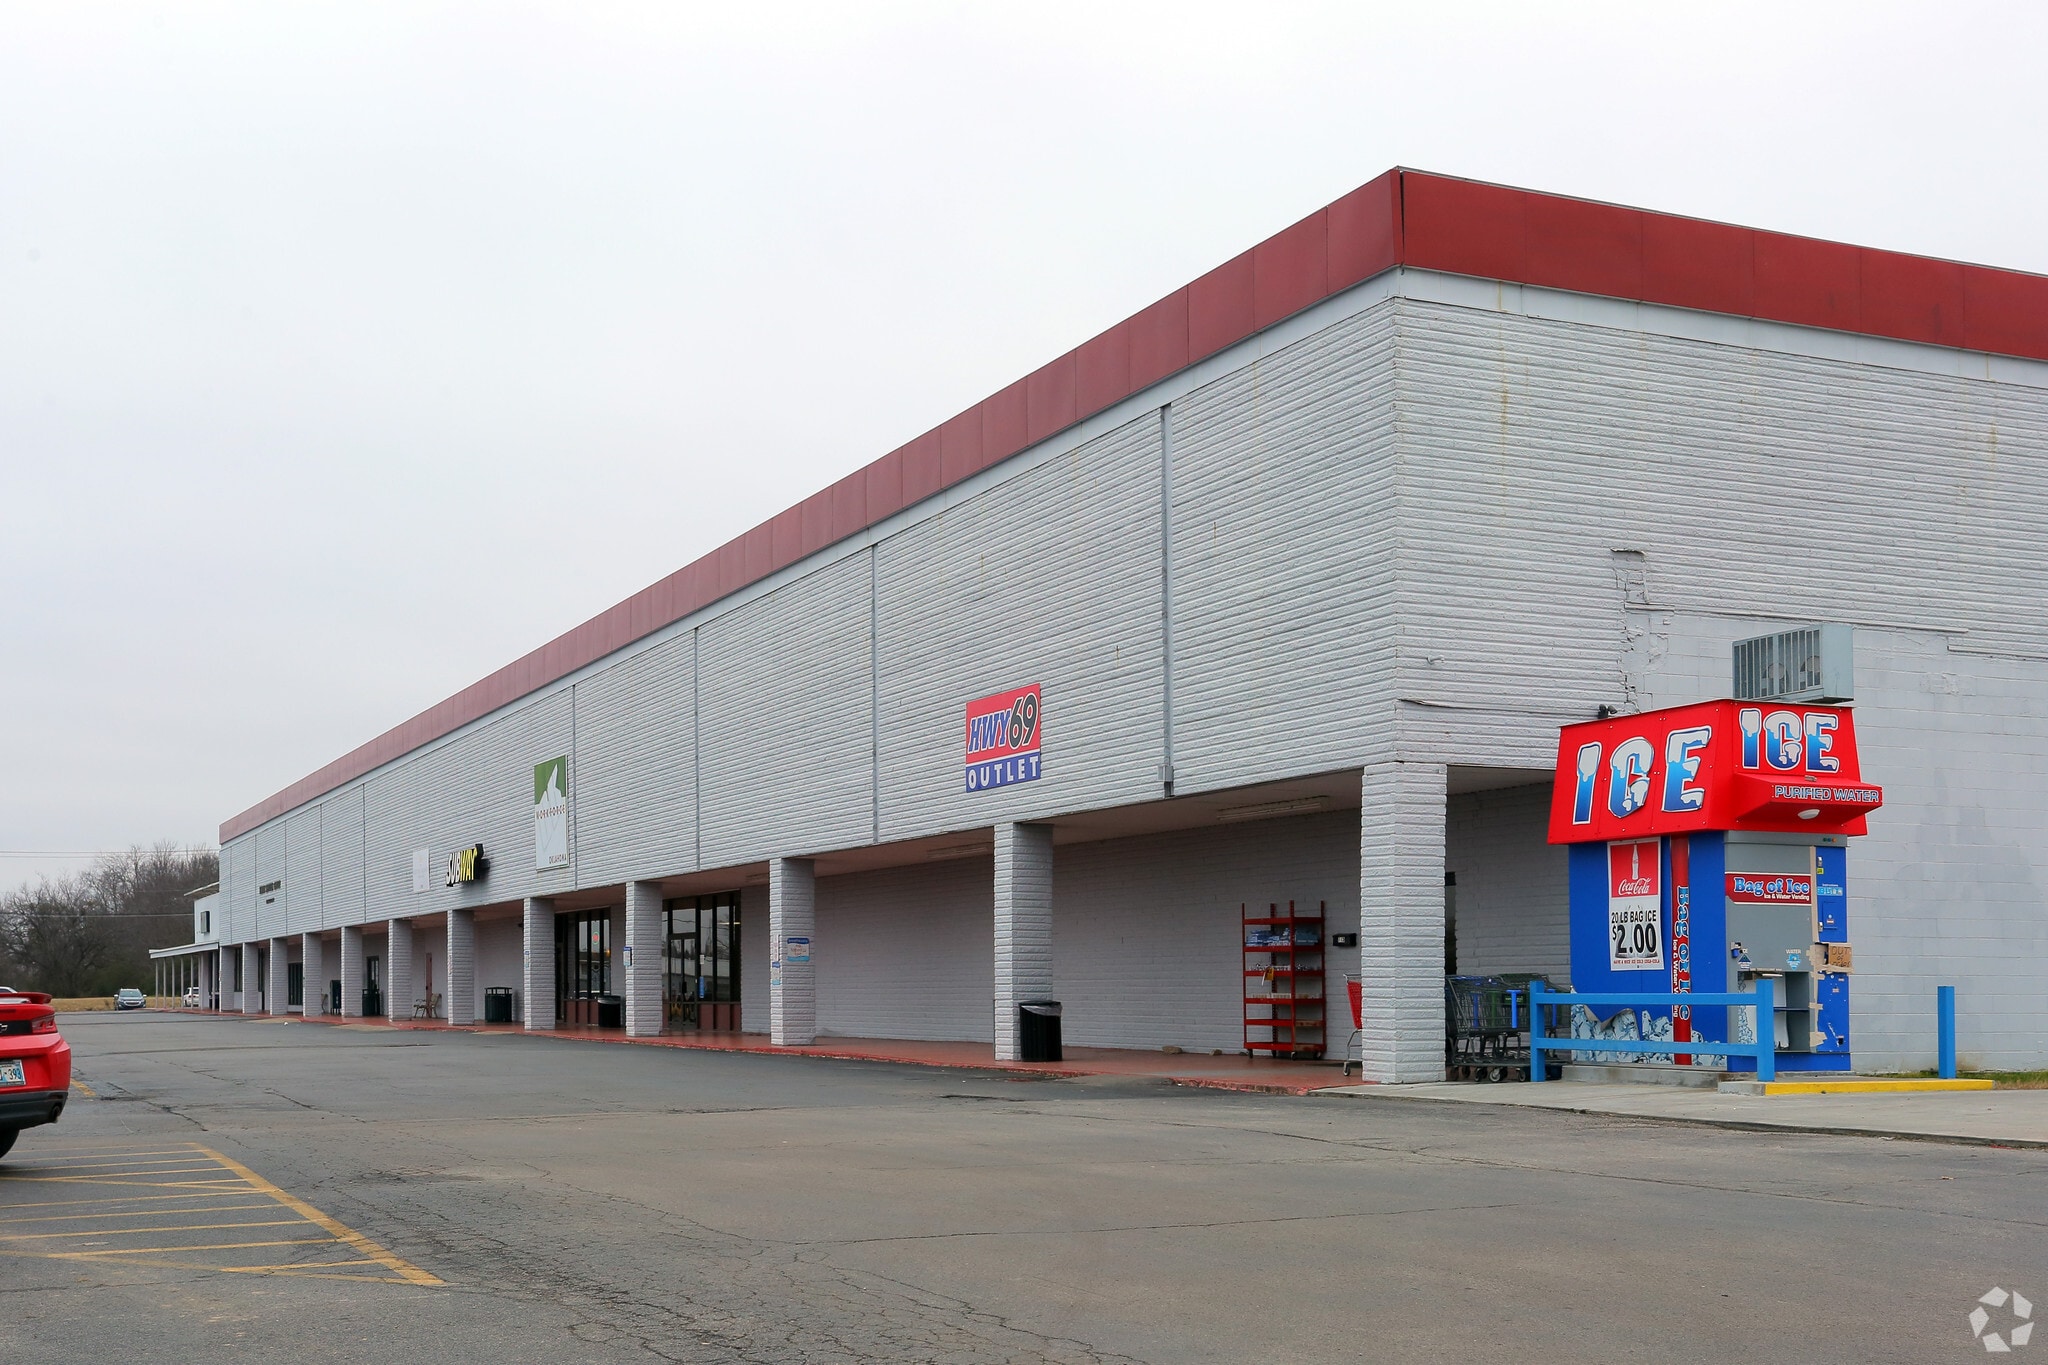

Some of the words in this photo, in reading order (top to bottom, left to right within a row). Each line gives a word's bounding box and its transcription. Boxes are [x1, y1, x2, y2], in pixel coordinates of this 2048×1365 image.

[967, 708, 1012, 754] HWY
[1008, 692, 1038, 750] 69
[1739, 708, 1840, 773] ICE
[968, 755, 1039, 789] OUTLET
[1572, 725, 1713, 825] ICE
[1775, 785, 1831, 801] PURIFIED
[1834, 788, 1880, 803] WATER
[446, 847, 478, 885] SUBWAY
[1734, 877, 1764, 897] Bag
[1766, 878, 1783, 894] of
[1786, 878, 1810, 895] Ice
[1611, 911, 1619, 924] 20
[1620, 911, 1629, 924] LB
[1630, 910, 1644, 923] BAG
[1645, 909, 1657, 922] ICE
[1675, 886, 1689, 938] Bag
[1612, 922, 1657, 954] $2.00
[1832, 946, 1851, 955] OUT
[1678, 943, 1689, 973] of
[1678, 979, 1690, 1020] Ie
